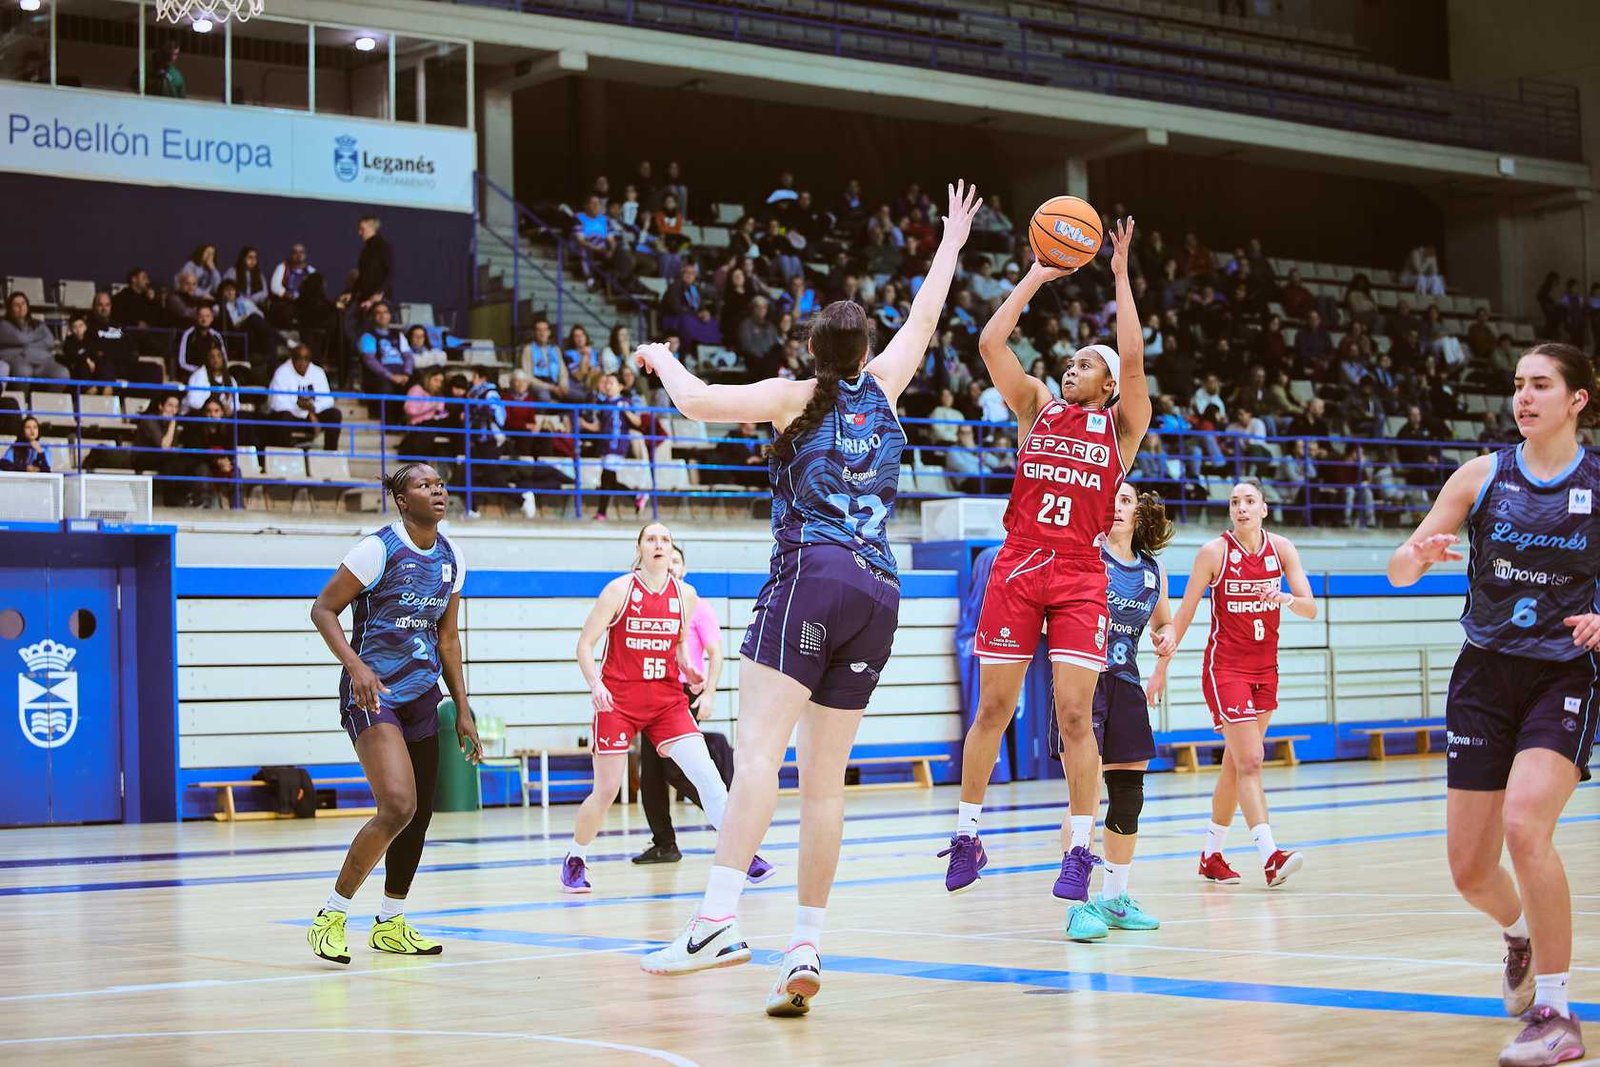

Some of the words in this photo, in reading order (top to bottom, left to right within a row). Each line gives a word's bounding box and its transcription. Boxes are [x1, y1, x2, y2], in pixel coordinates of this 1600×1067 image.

[9, 113, 149, 156] Pabellón
[162, 128, 272, 173] Europa
[363, 150, 435, 174] Leganés
[1030, 438, 1086, 459] SPAR
[1023, 462, 1102, 491] GIRONA
[826, 493, 888, 538] 12
[1037, 492, 1072, 527] 23
[1490, 521, 1588, 551] Leganés
[1511, 597, 1538, 628] 6
[630, 620, 672, 632] SPAR
[1253, 618, 1265, 641] 6
[412, 636, 429, 660] 2
[625, 637, 672, 652] GIRON
[1113, 642, 1128, 665] 8
[643, 656, 667, 680] 55
